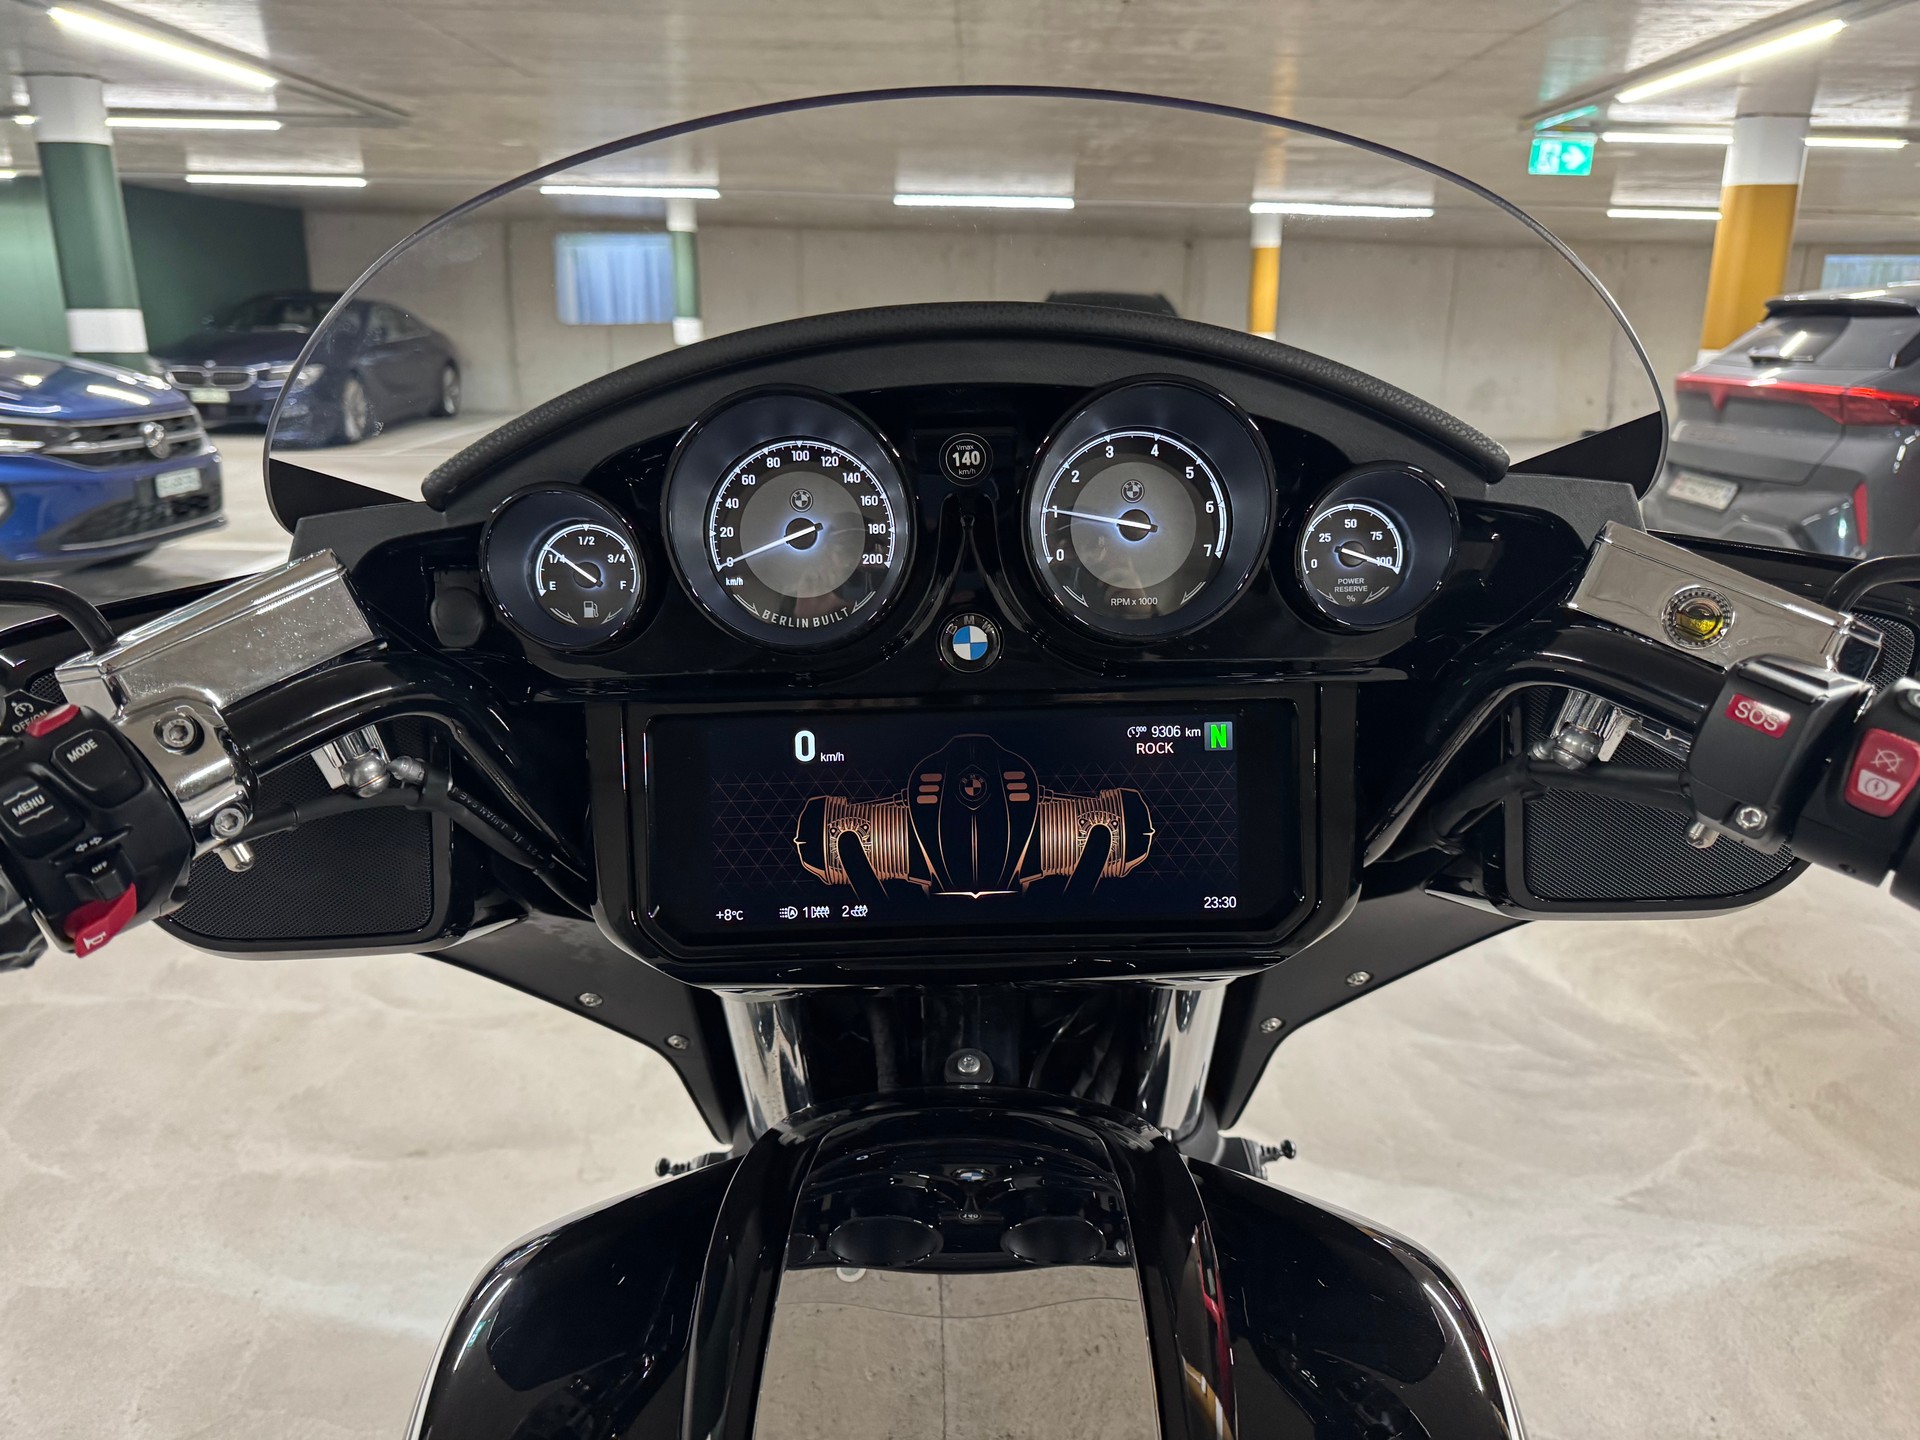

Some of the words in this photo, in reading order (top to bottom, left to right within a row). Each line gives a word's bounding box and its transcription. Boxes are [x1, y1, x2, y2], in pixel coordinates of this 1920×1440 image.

[791, 450, 810, 462] 100
[1105, 446, 1114, 459] 3
[1150, 444, 1159, 457] 4
[766, 457, 781, 468] 80
[821, 456, 839, 468] 120
[952, 451, 980, 467] 140
[843, 472, 861, 484] 140
[1071, 470, 1080, 483] 2
[1186, 467, 1194, 479] 5
[741, 474, 756, 486] 60
[725, 498, 740, 509] 40
[860, 495, 879, 507] 160
[1205, 501, 1215, 514] 6
[868, 523, 887, 535] 180
[1344, 519, 1358, 528] 50
[719, 526, 735, 538] 20
[1318, 533, 1332, 543] 25
[1370, 531, 1383, 541] 75
[578, 536, 596, 546] 1/2
[1056, 549, 1065, 561] 0
[1203, 544, 1212, 557] 7
[607, 554, 626, 564] 3/4
[862, 554, 883, 565] 200
[1310, 558, 1318, 569] 0
[549, 581, 557, 591] E
[619, 580, 627, 590] F
[725, 577, 744, 586] km/h
[1110, 598, 1131, 607] RPM
[1138, 597, 1158, 606] 1000
[761, 609, 809, 628] BERLIN
[812, 607, 849, 628] BUILT
[946, 614, 994, 634] BMW
[1734, 701, 1781, 732] SOS
[1151, 725, 1181, 738] 9306
[1185, 727, 1201, 737] km
[1210, 724, 1227, 749] N
[66, 739, 98, 763] MODE
[794, 730, 816, 762] 0
[820, 752, 845, 762] km/h
[1136, 742, 1174, 754] ROCK
[11, 795, 45, 818] MENU
[1203, 896, 1237, 909] 23:30
[802, 906, 809, 918] 1
[841, 905, 850, 918] 2
